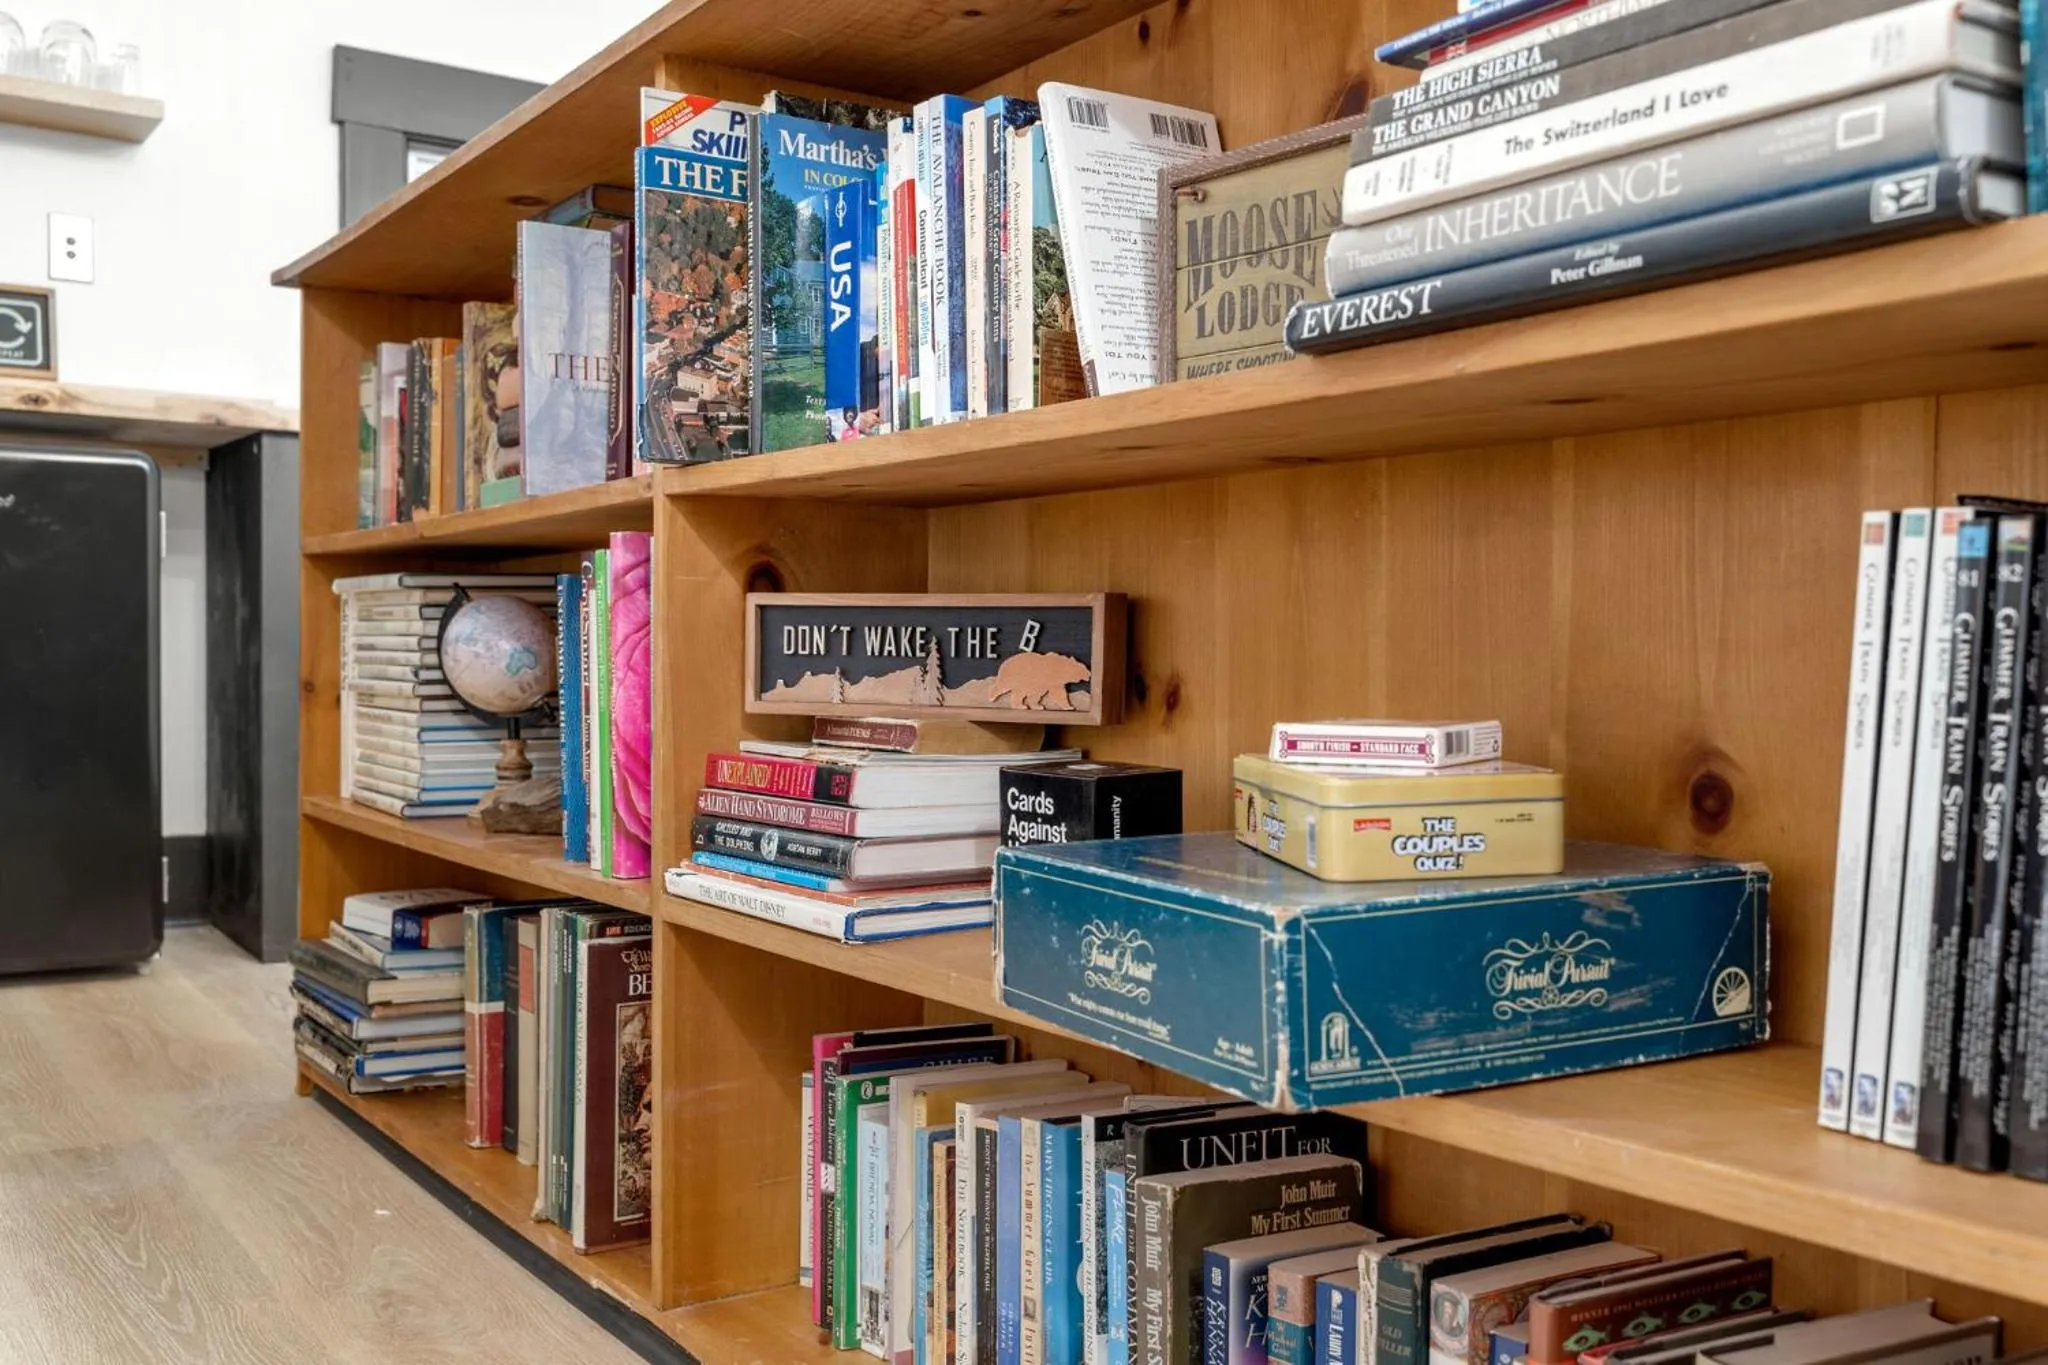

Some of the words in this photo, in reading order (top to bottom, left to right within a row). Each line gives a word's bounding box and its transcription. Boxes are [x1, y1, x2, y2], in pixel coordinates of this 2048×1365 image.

[1392, 83, 1427, 111] THE
[1429, 68, 1474, 97] HIGH
[1477, 45, 1543, 83] SIERRA
[932, 112, 941, 148] THE
[1372, 120, 1407, 145] THE
[1410, 100, 1474, 135] GRAND
[1477, 74, 1561, 115] CANYON
[1504, 137, 1534, 157] The
[1542, 101, 1656, 147] Switzerland
[1663, 95, 1671, 113] I
[1679, 82, 1730, 108] Love
[778, 129, 877, 171] Martha's
[655, 155, 724, 193] THE
[805, 169, 820, 184] IN
[822, 172, 863, 187] COL
[933, 154, 944, 252] AVALANCHE
[1424, 153, 1684, 252] INHERITANCE
[919, 210, 928, 288] Connecticut
[1185, 190, 1318, 312] MOOSE
[1550, 266, 1587, 285] Peter
[1588, 255, 1643, 278] Gillman
[830, 241, 852, 332] USA
[935, 258, 946, 307] BOOK
[992, 263, 1000, 312] Country
[1301, 280, 1443, 340] EVEREST
[549, 353, 610, 382] THE
[783, 624, 852, 655] DON'T
[864, 626, 927, 658] WAKE
[948, 626, 998, 659] THE
[1018, 618, 1041, 653] B
[1950, 612, 1976, 704] GLIMMER
[1993, 607, 2020, 701] GLIMMER
[1947, 713, 1970, 774] TRAIN
[1989, 710, 2013, 772] TRAIN
[705, 790, 731, 813] ALIEN
[732, 795, 756, 818] HAND
[757, 800, 805, 825] SYNDROME
[1007, 786, 1054, 815] Cards
[1007, 814, 1067, 844] Against
[1423, 817, 1456, 833] THE
[1941, 784, 1965, 862] STORIES
[1983, 782, 2008, 862] STORIES
[714, 835, 725, 846] THE
[726, 837, 755, 852] DOLPHINS
[806, 846, 822, 857] BERRY
[1393, 833, 1486, 856] COUPLES
[699, 884, 713, 899] THE
[714, 888, 727, 900] ART
[727, 890, 737, 903] OF
[737, 892, 757, 912] WALT
[759, 898, 786, 918] DISNEY
[1486, 958, 1550, 999] Trivial
[1552, 950, 1615, 984] Pursuit
[827, 1119, 835, 1161] Believer
[1045, 1134, 1053, 1172] MARY
[1180, 1126, 1296, 1171] UNFIT
[1297, 1137, 1333, 1155] FOR
[957, 1178, 967, 1201] THE
[1025, 1181, 1034, 1239] Summer
[1045, 1176, 1053, 1237] HIGGINS
[1126, 1154, 1137, 1224] UNFIT
[1281, 1183, 1307, 1209] John
[1308, 1180, 1337, 1199] Muir
[824, 1199, 834, 1256] NICHOLAS
[1142, 1196, 1161, 1236] John
[1251, 1214, 1270, 1235] My
[1272, 1209, 1301, 1230] First
[1303, 1203, 1351, 1228] Summer
[957, 1208, 967, 1279] NOTEBOOK
[1045, 1239, 1053, 1285] CLARK
[1085, 1248, 1093, 1266] OF
[1127, 1229, 1135, 1254] FOR
[1146, 1236, 1162, 1270] Muir
[824, 1257, 834, 1299] SPARKS
[1025, 1250, 1034, 1291] Guest
[1085, 1269, 1094, 1362] HUMANKIND
[1146, 1288, 1162, 1314] My
[1146, 1314, 1162, 1352] First
[1329, 1324, 1344, 1357] LARRY
